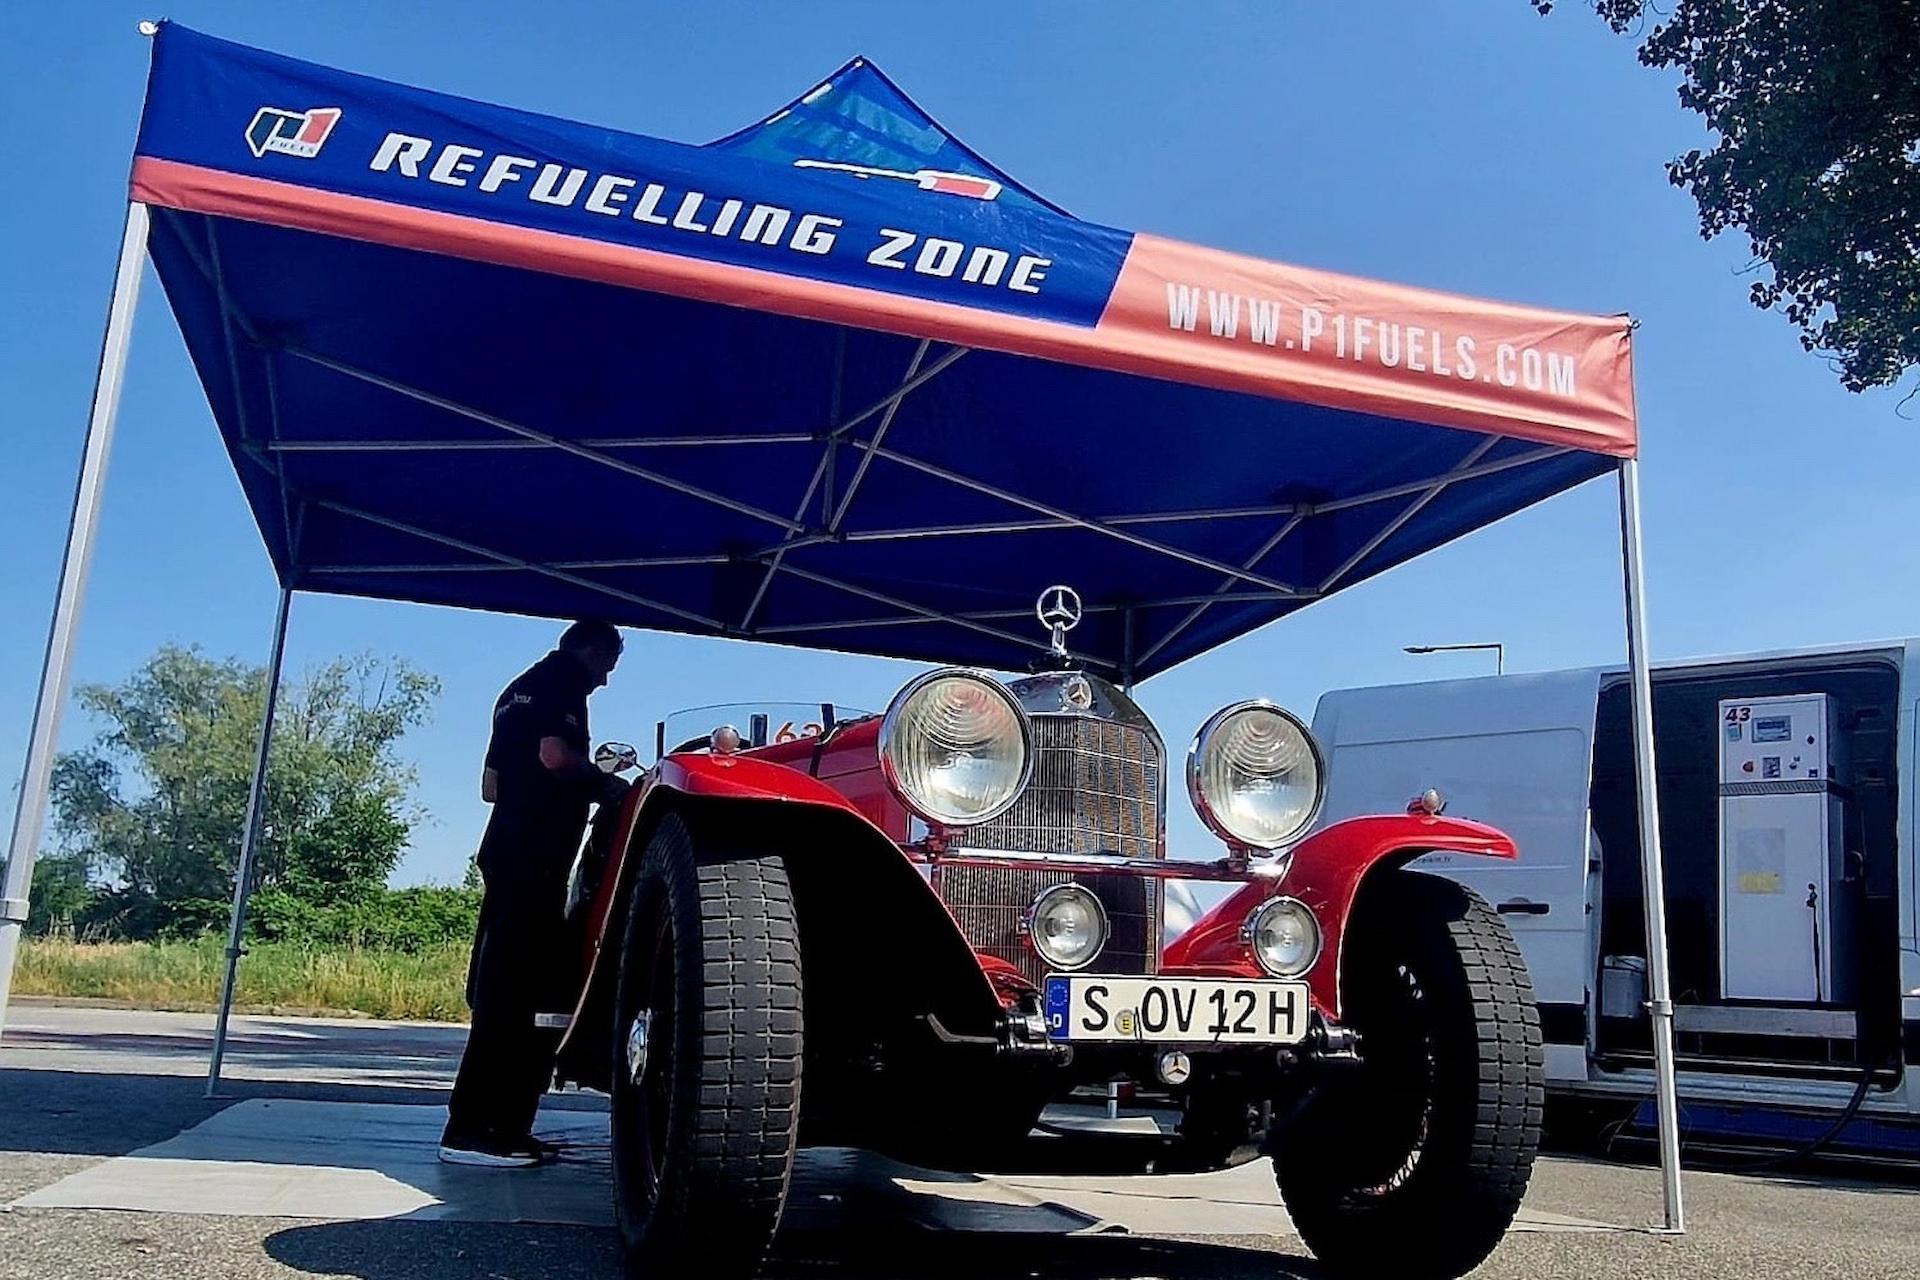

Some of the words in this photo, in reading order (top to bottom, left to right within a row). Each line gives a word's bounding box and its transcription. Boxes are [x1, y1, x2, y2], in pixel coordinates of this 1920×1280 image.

[370, 132, 843, 254] REFUELLING
[867, 228, 1053, 294] ZONE
[1165, 281, 1577, 397] WWW.P1FUELS.COM
[1725, 707, 1751, 721] 43
[1082, 985, 1109, 1031] S
[1141, 986, 1197, 1033] OV
